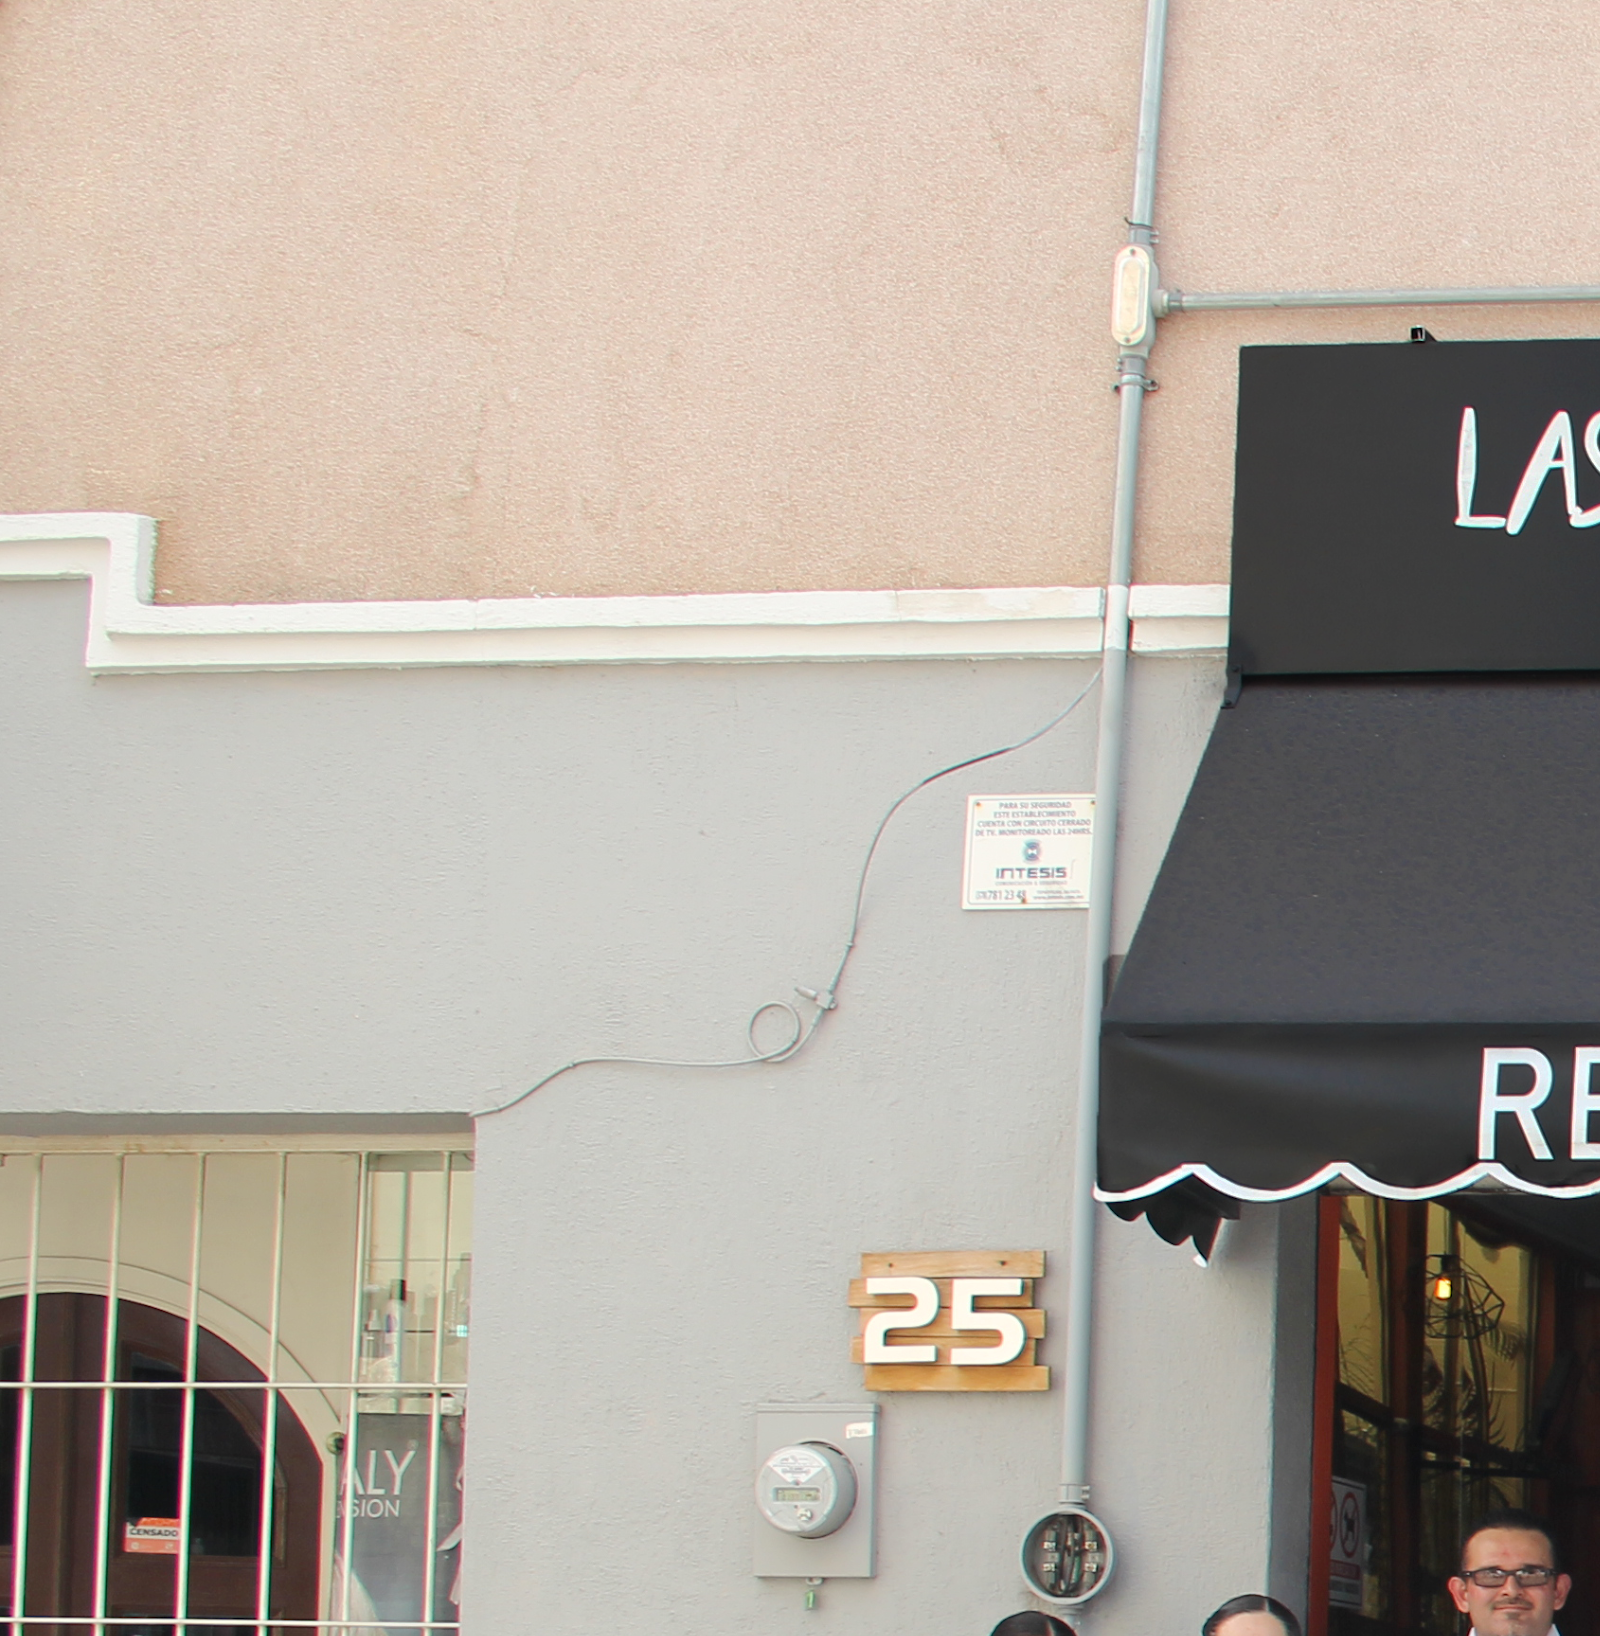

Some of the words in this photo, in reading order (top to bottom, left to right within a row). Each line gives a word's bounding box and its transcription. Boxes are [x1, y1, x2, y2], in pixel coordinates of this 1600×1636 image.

[996, 867, 1067, 879] INTESIS
[863, 1276, 1027, 1366] 25
[129, 1527, 179, 1538] CENSADO
